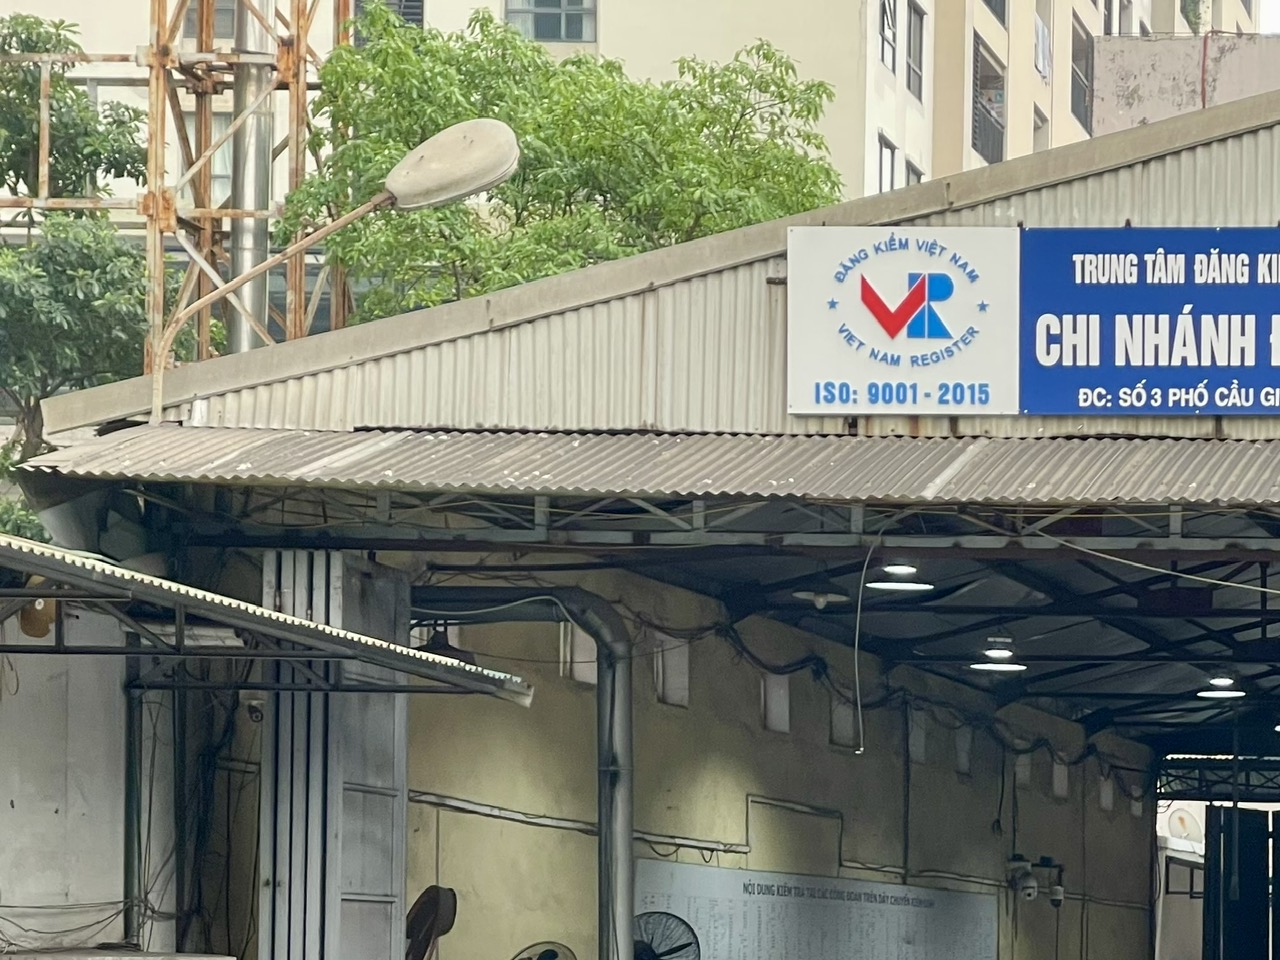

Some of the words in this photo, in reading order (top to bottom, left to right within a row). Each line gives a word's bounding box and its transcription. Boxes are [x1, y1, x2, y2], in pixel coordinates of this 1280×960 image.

[834, 260, 869, 283] ĐĂNG
[873, 231, 909, 255] KIỂM
[916, 238, 947, 257] VIỆT
[949, 252, 979, 284] NAM
[1073, 253, 1138, 285] TRUNG
[1144, 247, 1185, 285] TÂM
[1194, 247, 1249, 285] ĐĂNG
[838, 322, 866, 351] VIET
[869, 347, 901, 367] NAM
[910, 325, 980, 368] REGISTER
[1035, 314, 1100, 367] CHI
[1115, 304, 1255, 367] NHÁNH
[814, 381, 858, 404] ISO:
[868, 381, 918, 405] 9001
[937, 382, 990, 405] 2015
[1078, 387, 1113, 408] ĐC:
[1119, 379, 1150, 408] SỐ
[1150, 386, 1163, 408] 3
[1168, 379, 1209, 408] PHỐ
[1215, 379, 1255, 408] CẦU
[756, 883, 775, 896] DUNG
